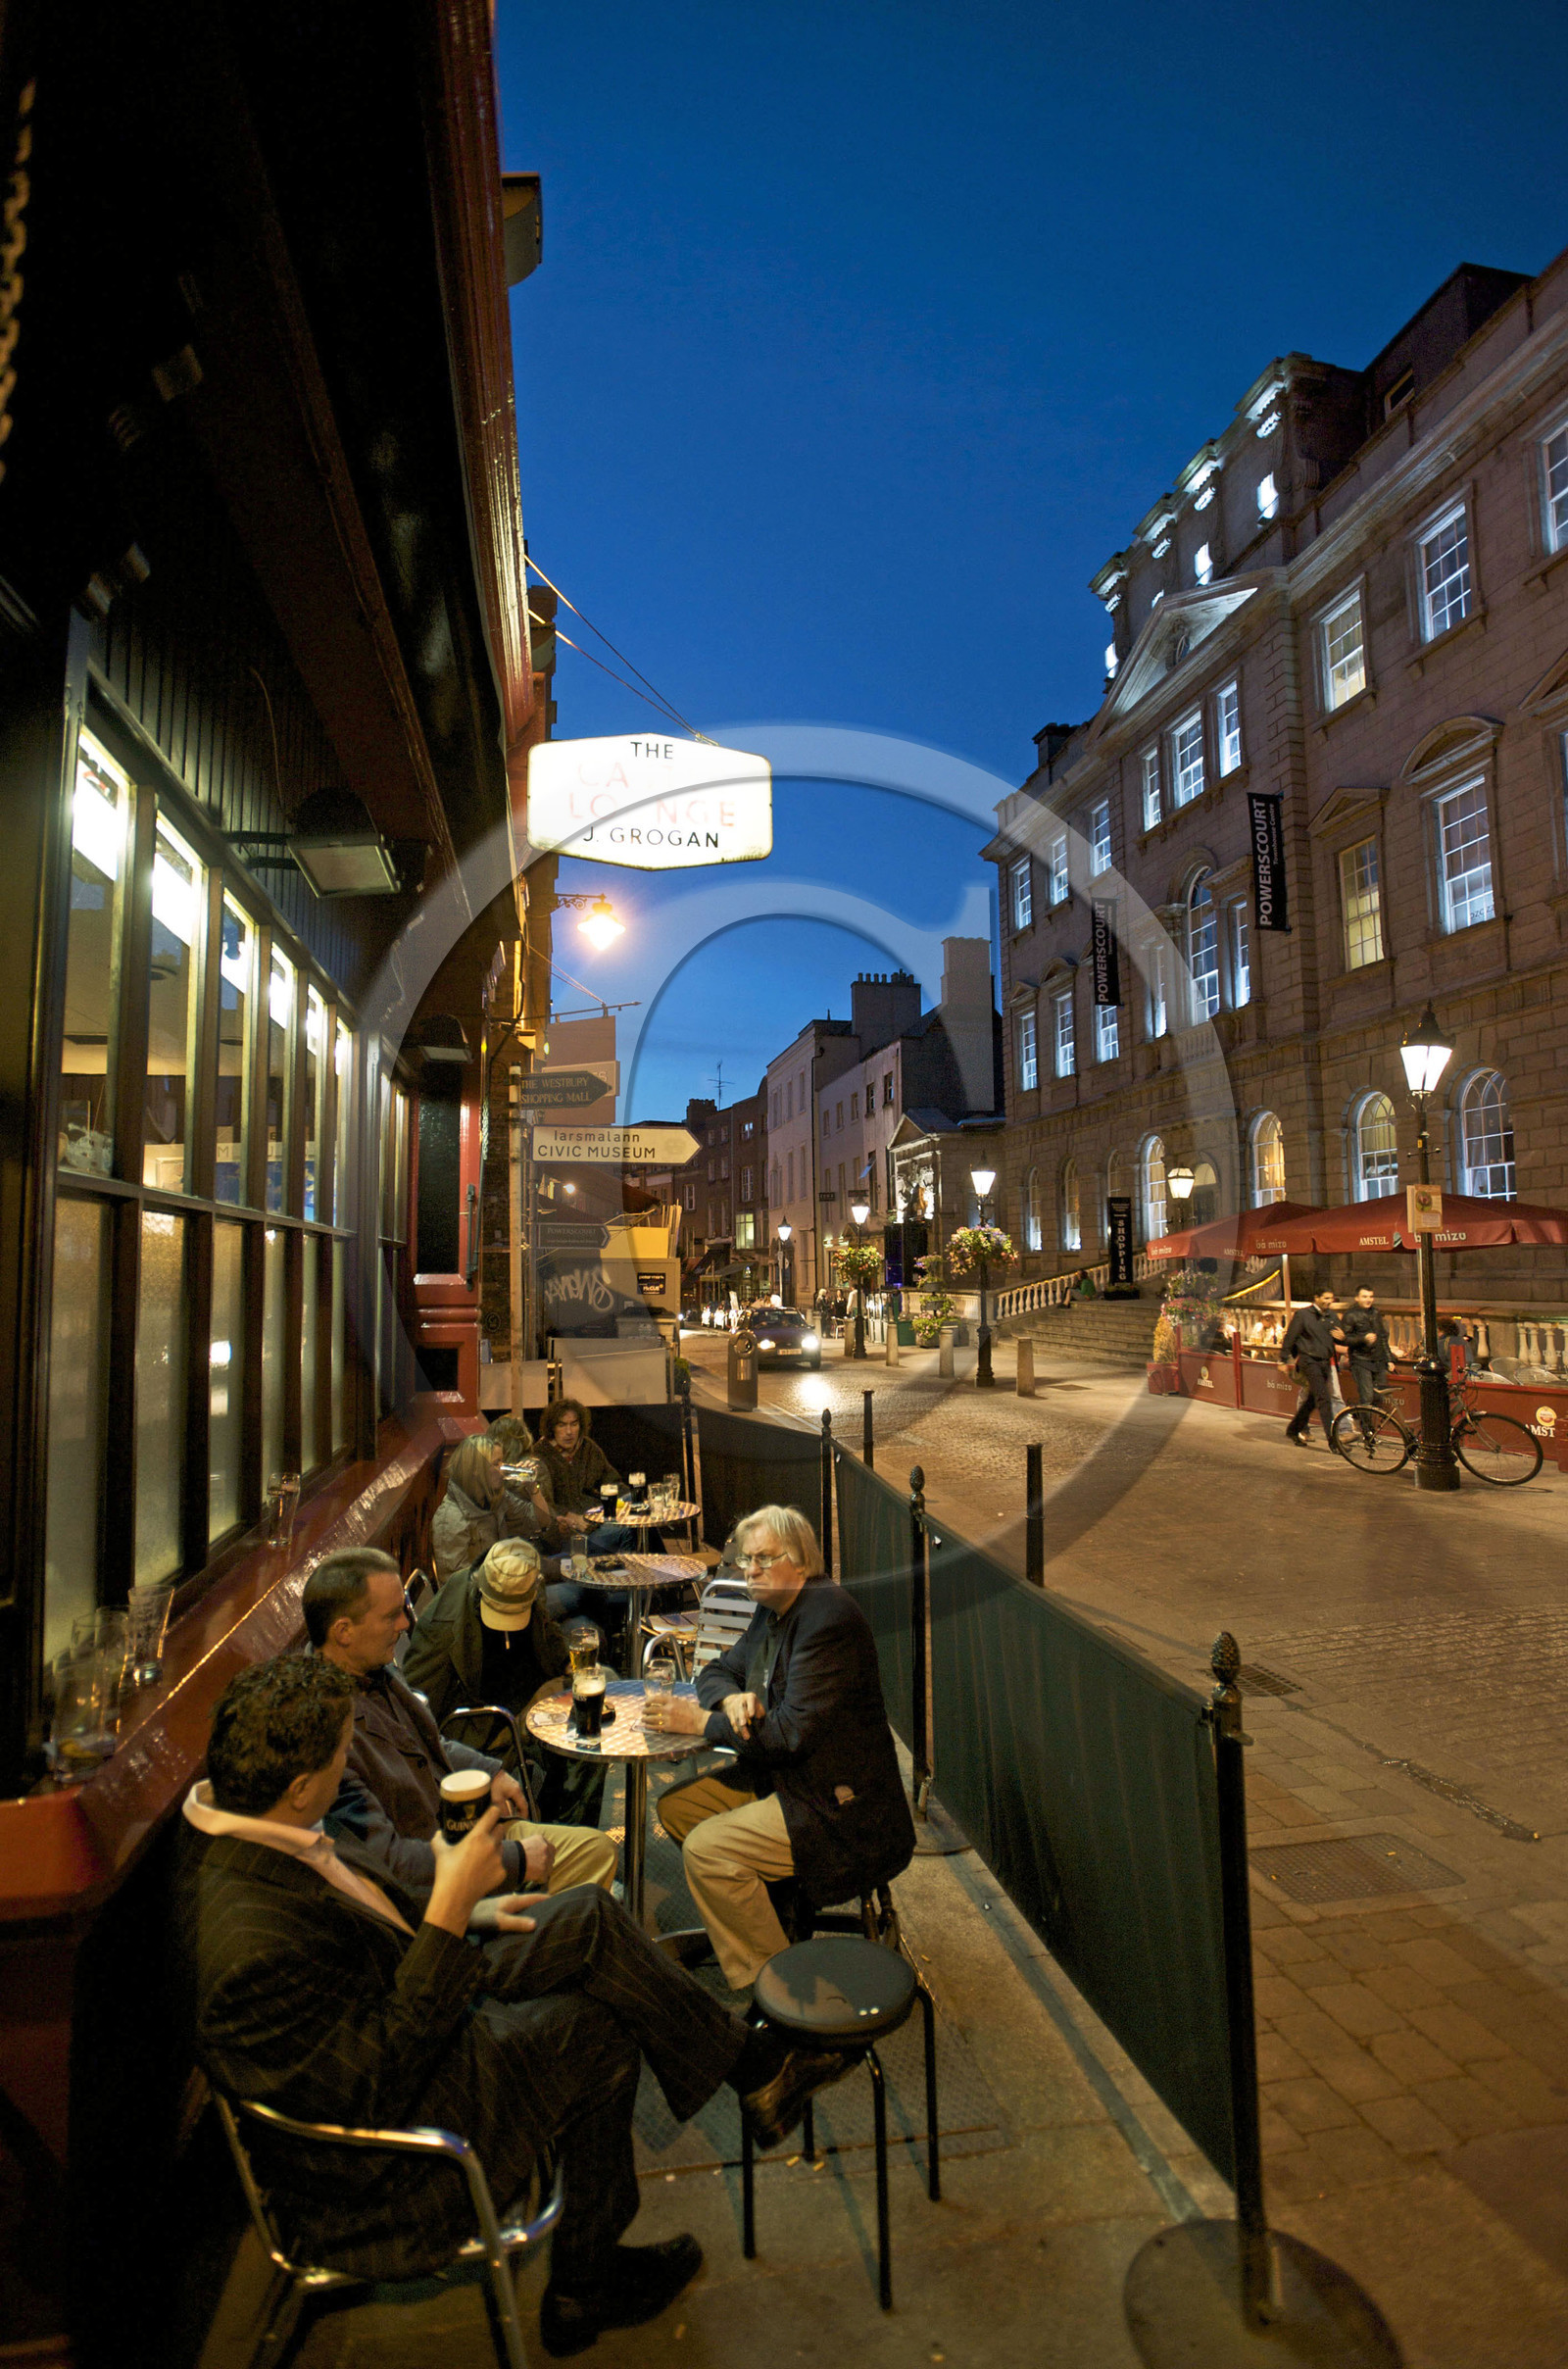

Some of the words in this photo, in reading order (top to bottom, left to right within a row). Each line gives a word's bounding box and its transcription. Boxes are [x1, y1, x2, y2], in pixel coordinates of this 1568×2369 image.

[630, 741, 674, 760] THE
[568, 792, 736, 827] LONGE
[610, 827, 719, 849] GROGAN
[1252, 798, 1273, 926] POWERSCOURT
[1094, 901, 1109, 1003] POWERSCOURT
[521, 1079, 538, 1089] THE
[542, 1076, 590, 1088] WESTBURY
[520, 1092, 564, 1104] SHOPPING
[566, 1091, 592, 1102] MALL
[537, 1145, 582, 1158] CIVIC
[588, 1146, 656, 1159] MUSEUM
[1117, 1219, 1127, 1280] SHOPPING
[1358, 1235, 1389, 1246] AMSTEL
